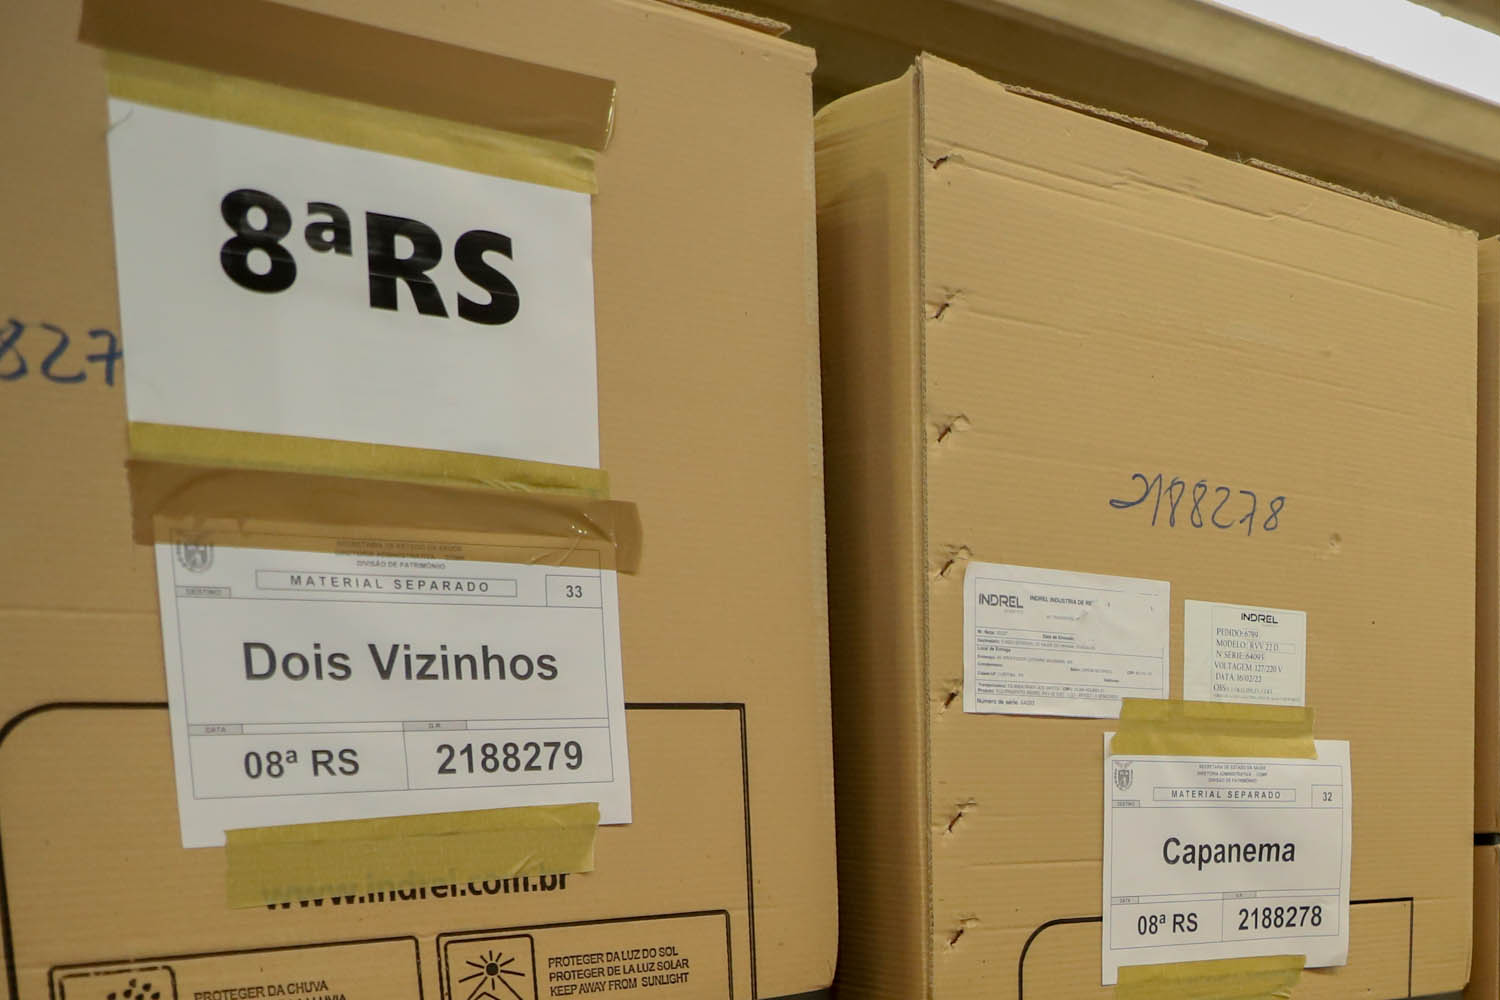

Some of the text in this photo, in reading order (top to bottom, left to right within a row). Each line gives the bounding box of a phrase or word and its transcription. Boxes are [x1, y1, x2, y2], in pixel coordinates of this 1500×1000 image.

[290, 574, 490, 594] MATERIAL SEPARADO
[565, 584, 583, 599] 33
[979, 593, 1023, 608] INDREL
[1241, 613, 1278, 624] INDREL
[242, 640, 559, 682] Dois Vizinhos
[311, 747, 361, 777] RS
[436, 739, 584, 776] 2188279
[1171, 789, 1281, 800] MATERIAL SEPARADO
[1322, 791, 1333, 802] 32
[1162, 837, 1296, 871] Capanema
[1172, 912, 1198, 933] RS
[1238, 905, 1322, 931] 2188278
[548, 946, 678, 968] PROTEGER DA LUZ DO SOL
[549, 959, 689, 982] PROTEGER DE LA LUZ SOLAR
[268, 984, 285, 997] DA
[287, 980, 329, 994] CHUVA
[550, 972, 689, 997] KEEP AWAY FROM SUNLIGHT
